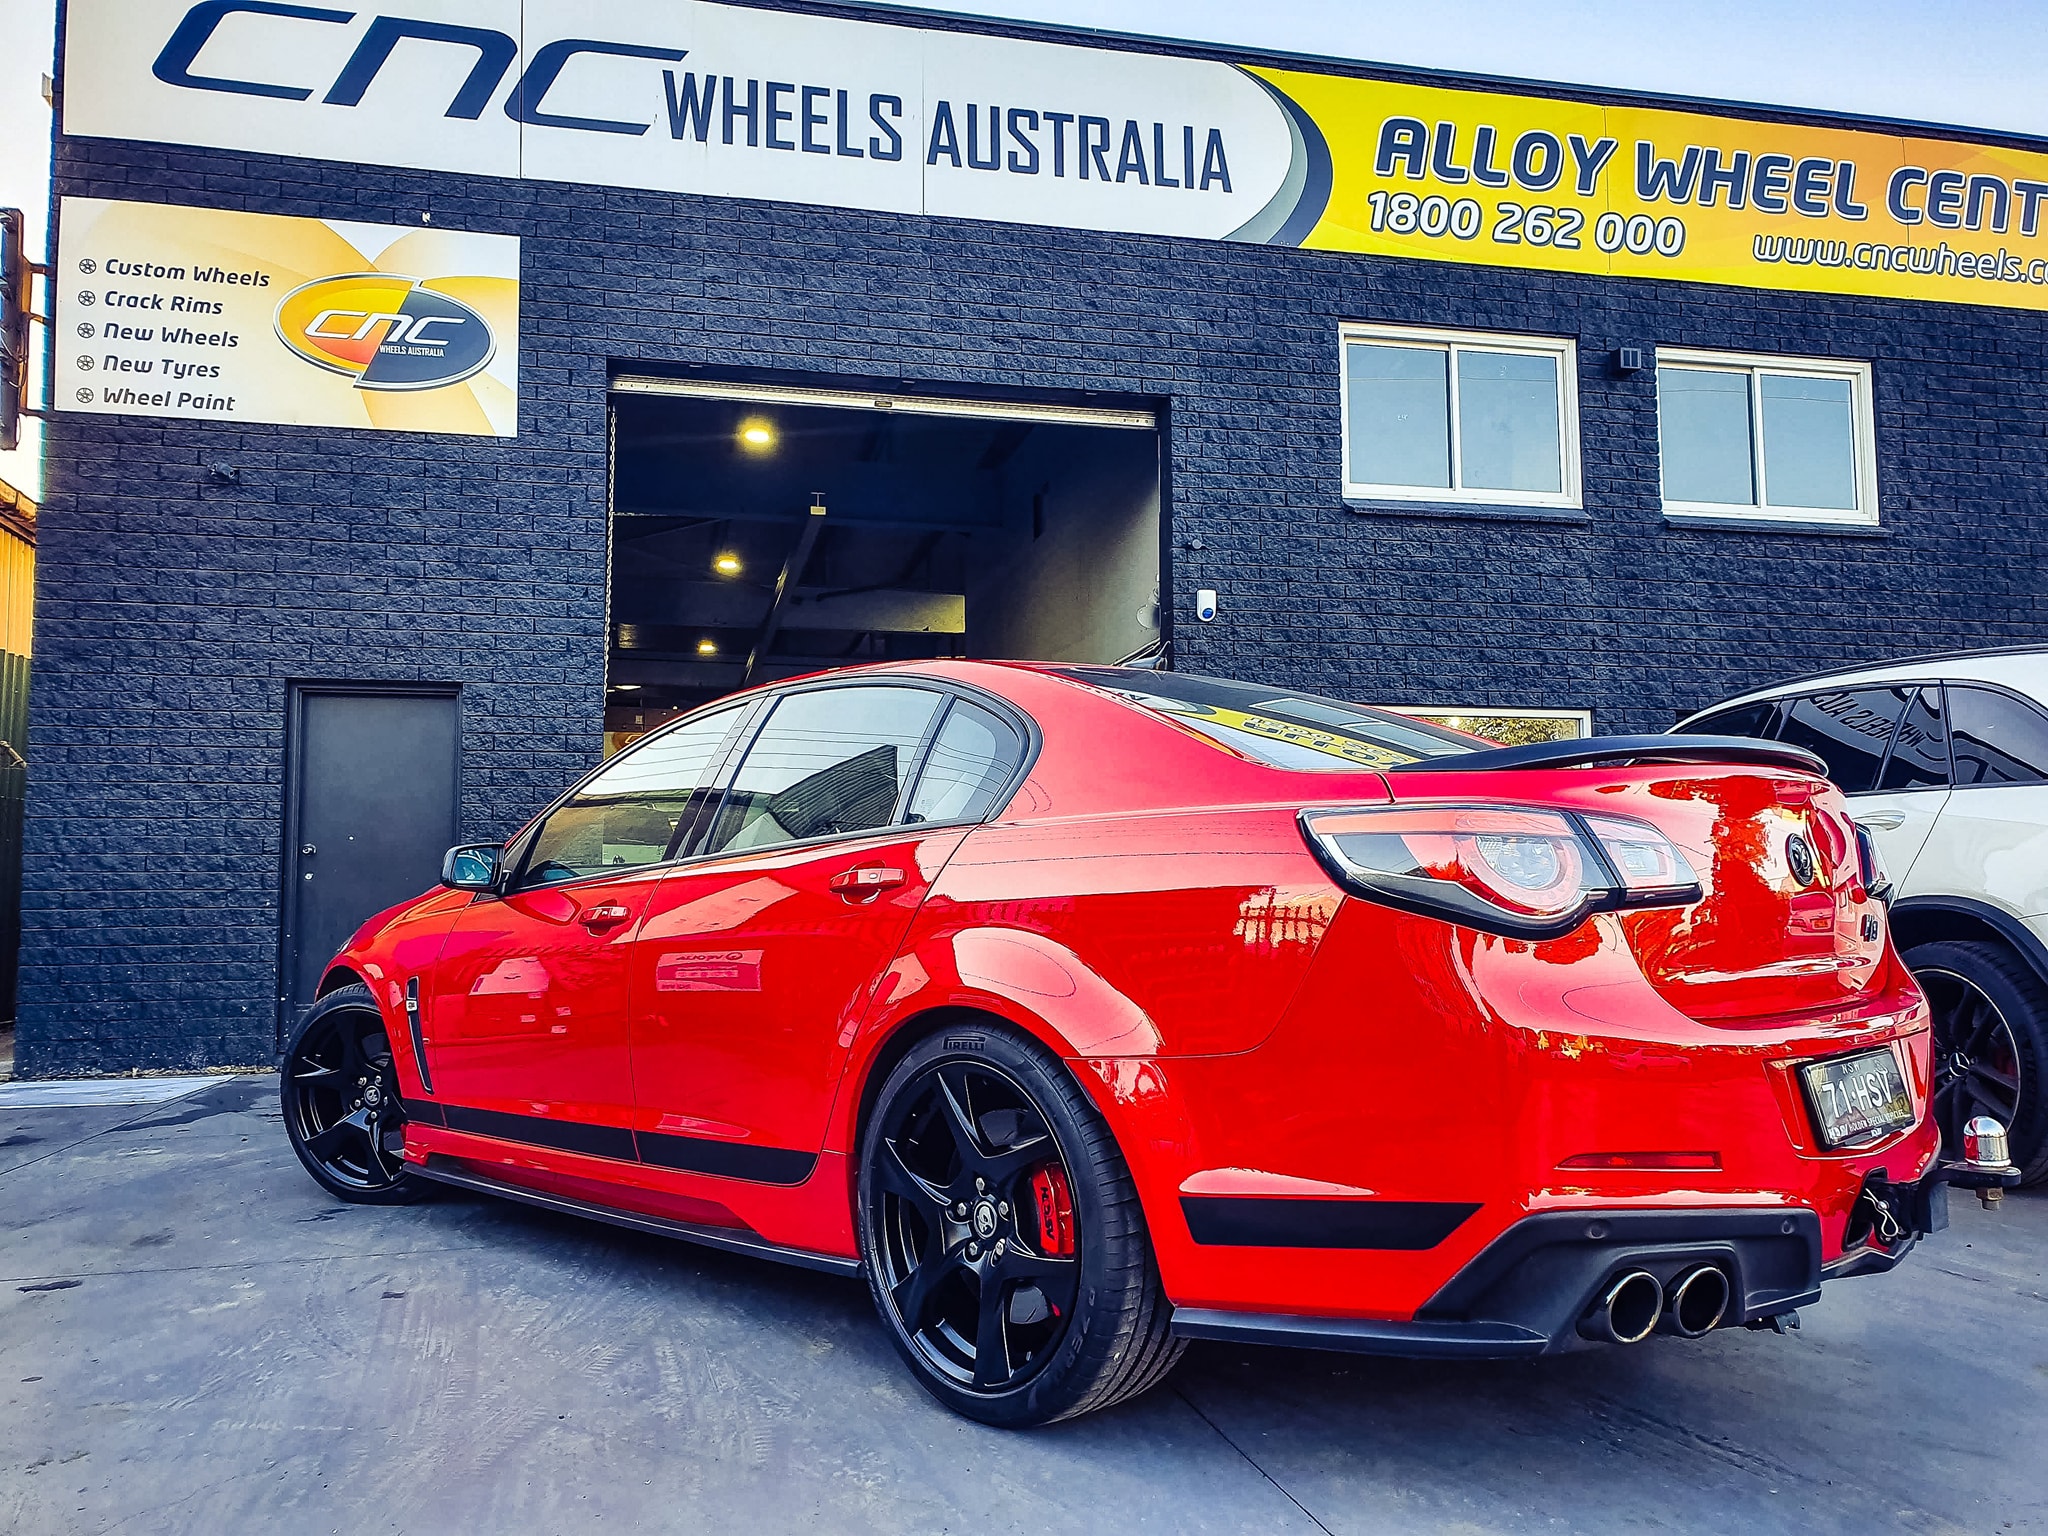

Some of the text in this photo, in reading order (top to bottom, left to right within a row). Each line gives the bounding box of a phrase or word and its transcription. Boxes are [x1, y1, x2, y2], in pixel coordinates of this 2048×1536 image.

[662, 69, 902, 162] WHEELS
[926, 99, 1232, 193] AUSTRALIA
[1373, 115, 1618, 196] ALLOY
[1634, 139, 1868, 220] WHEEL
[1368, 191, 1686, 258] 1800 262 000
[1752, 233, 2048, 283] www.cncwheels.c
[105, 258, 271, 287] Custom Wheels
[104, 290, 223, 315] Crack Rims
[103, 322, 239, 348] New Wheels
[379, 344, 445, 357] WHEELS AUSTRALIA
[103, 355, 220, 379] New Tyres
[103, 387, 235, 411] Wheel Paint
[942, 1035, 986, 1051] PIRELLI
[1841, 1062, 1861, 1075] NSW
